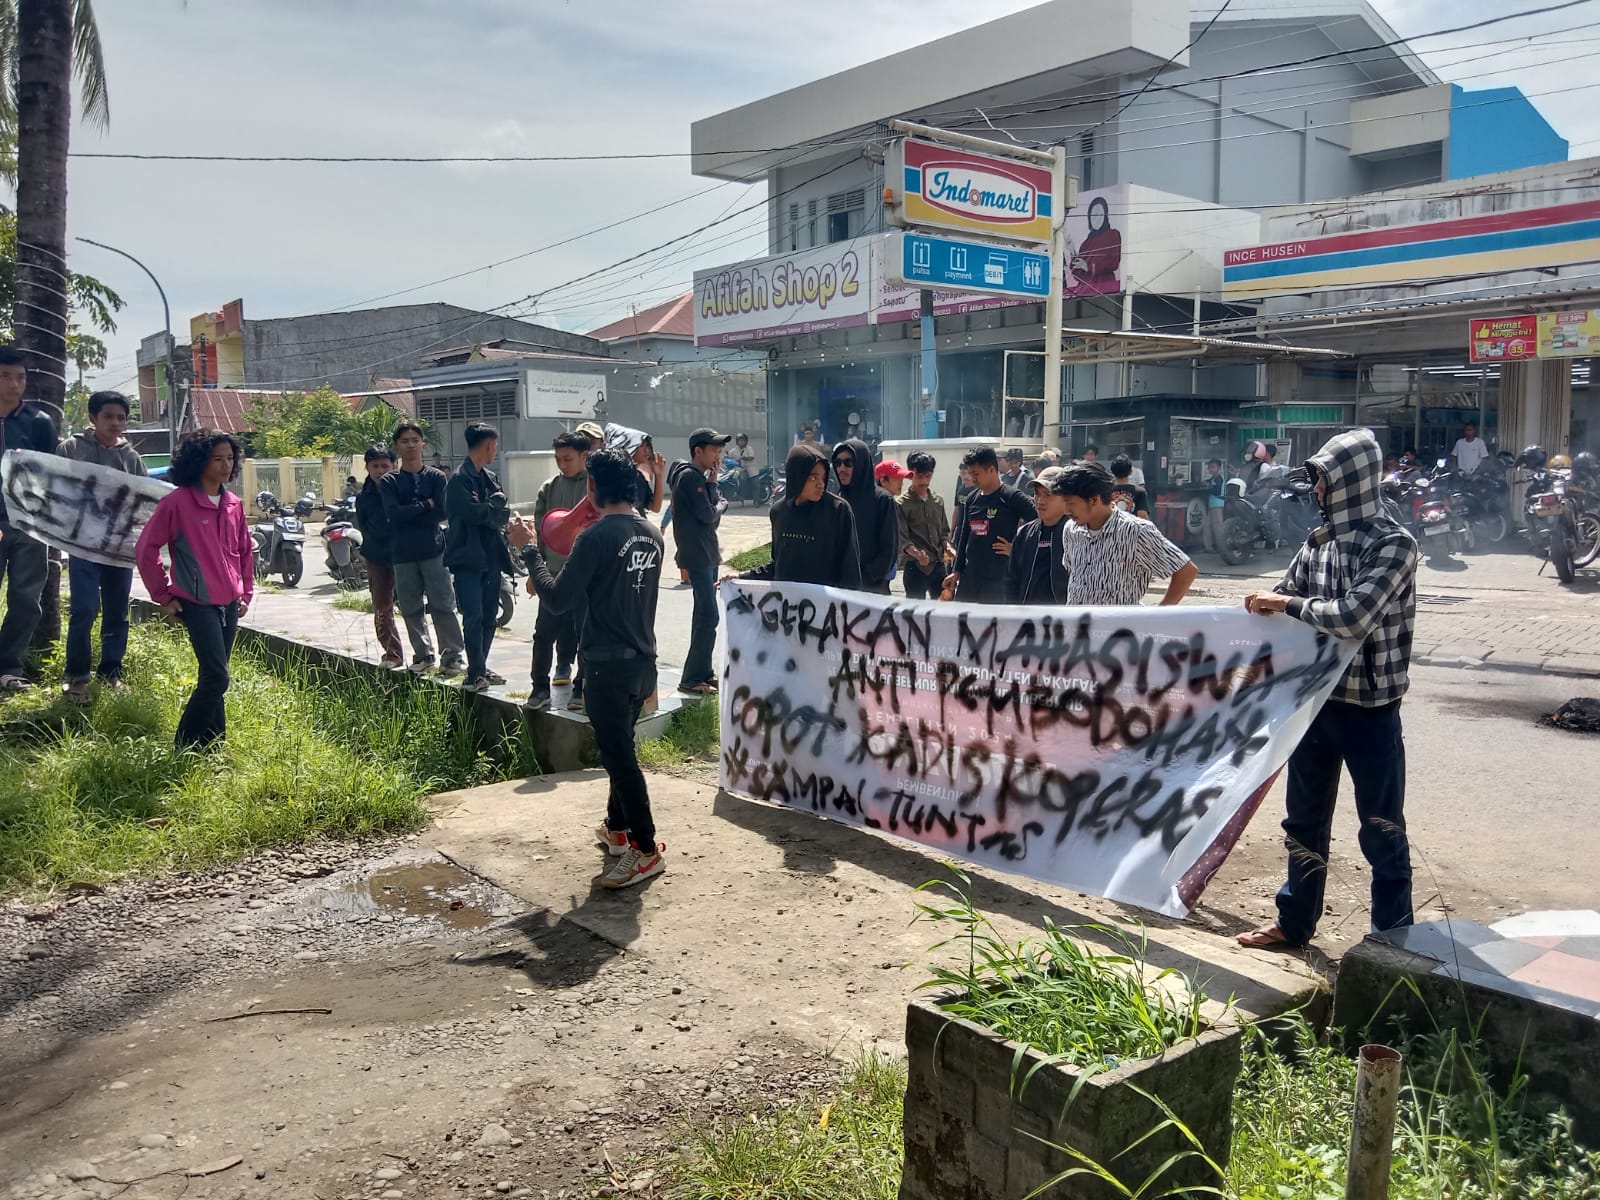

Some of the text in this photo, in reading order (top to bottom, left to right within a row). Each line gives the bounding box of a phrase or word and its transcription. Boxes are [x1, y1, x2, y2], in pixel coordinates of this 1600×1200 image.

[929, 171, 1029, 213] Indomaret
[912, 267, 931, 276] pulsa
[1229, 243, 1306, 263] INCE HUSEIN
[702, 250, 859, 318] Afifah Shop 2
[944, 271, 973, 281] payment
[1491, 320, 1522, 330] Hemat
[757, 591, 1275, 701] GERAKAN MAHASISWA
[828, 648, 917, 723] ANTI
[731, 685, 847, 758] COPOT
